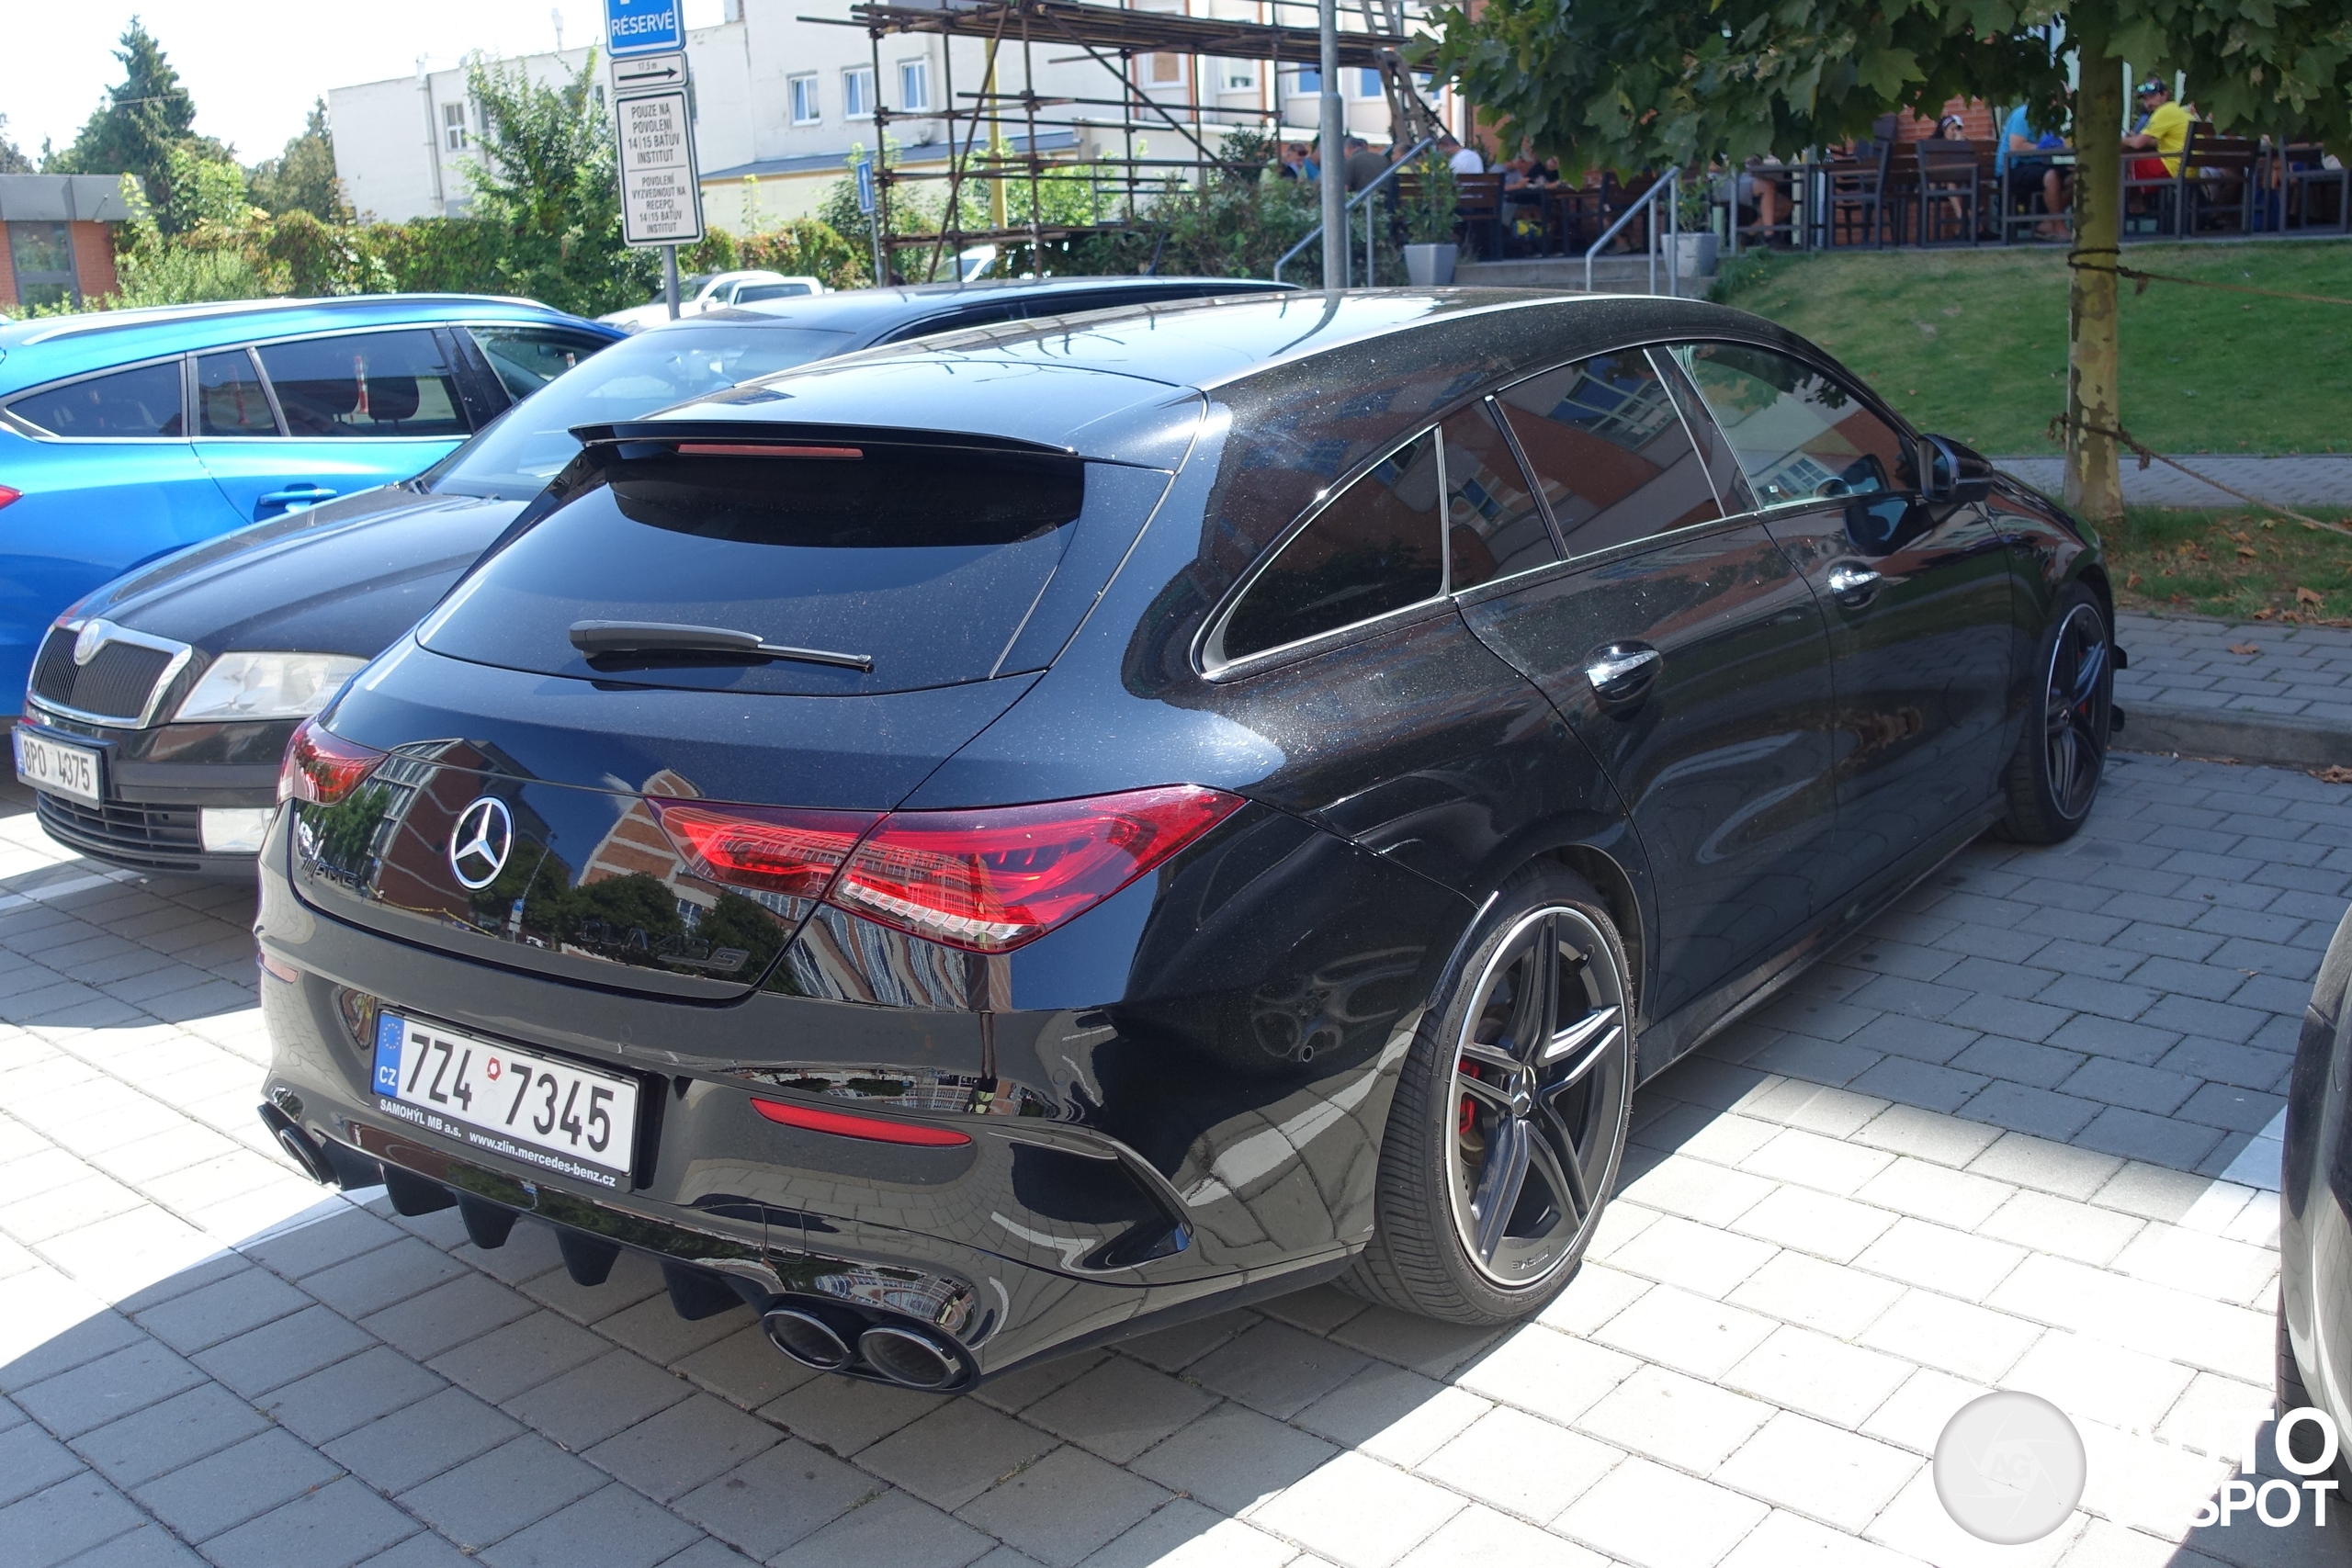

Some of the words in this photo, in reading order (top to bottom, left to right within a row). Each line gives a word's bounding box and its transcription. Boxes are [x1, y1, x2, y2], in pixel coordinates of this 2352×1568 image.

[611, 8, 674, 37] RÉSERVÉ
[631, 104, 658, 118] POUZE
[659, 103, 672, 116] NA
[632, 116, 673, 134] POVOLENÍ
[637, 149, 674, 164] INSTITUT
[641, 172, 675, 187] POVOLENÍ
[631, 186, 675, 199] VYZVEDNOUT
[676, 186, 687, 197] NA
[646, 198, 674, 210] RECEPCI
[646, 222, 677, 234] INSTITUT
[57, 750, 90, 791] 4375
[580, 919, 649, 951] CLA
[379, 1065, 396, 1087] CZ
[406, 1032, 473, 1111] 7Z4
[505, 1063, 614, 1153] 7345
[379, 1099, 425, 1125] SAMOHÝL
[427, 1114, 443, 1130] MB
[444, 1122, 462, 1138] a.s.
[469, 1131, 616, 1188] www.zlin.mercedes-benz.cz
